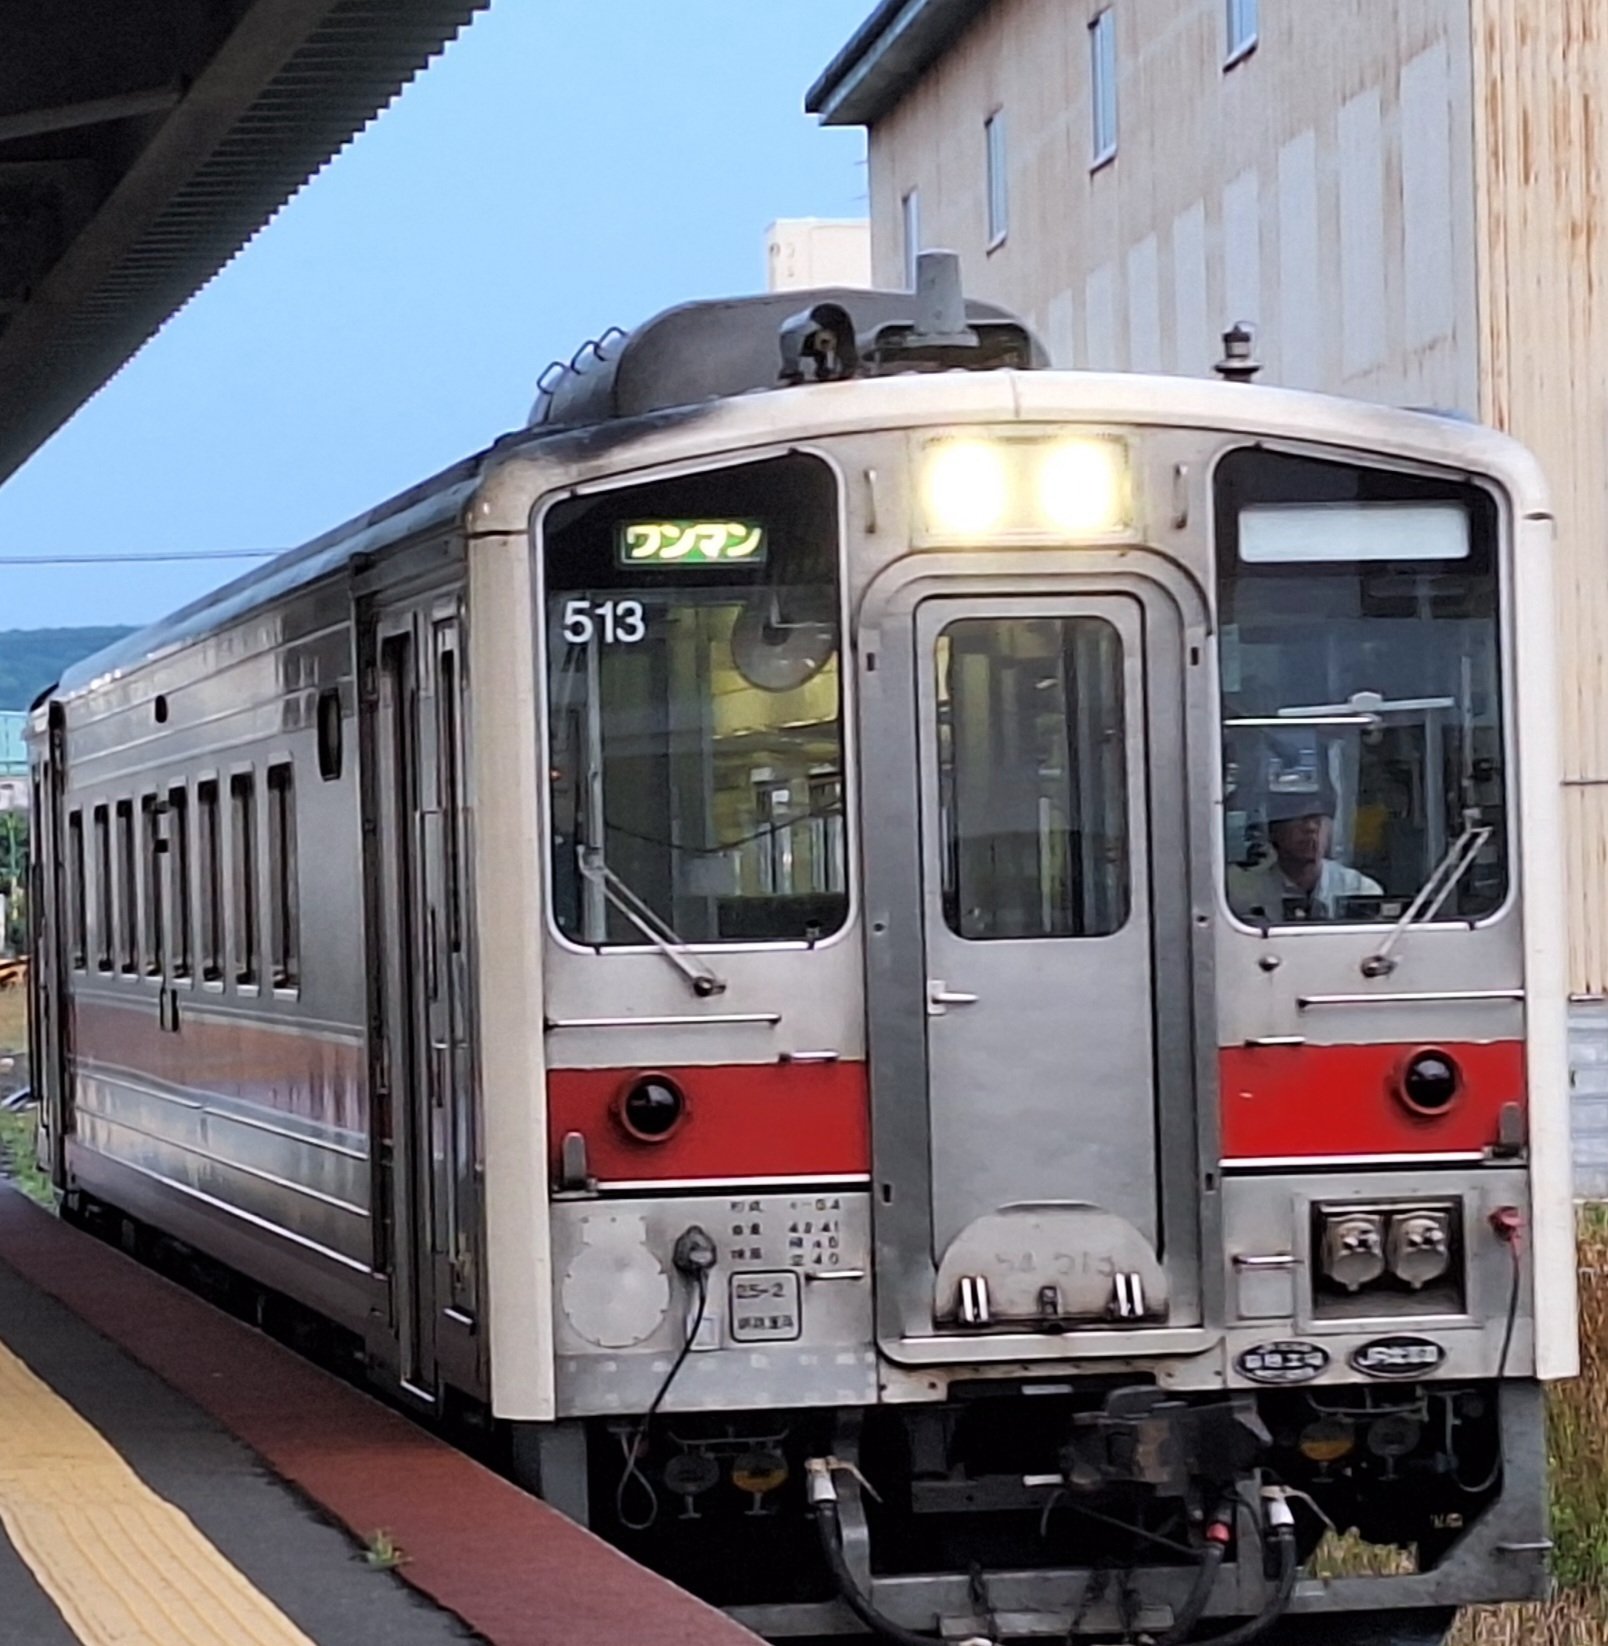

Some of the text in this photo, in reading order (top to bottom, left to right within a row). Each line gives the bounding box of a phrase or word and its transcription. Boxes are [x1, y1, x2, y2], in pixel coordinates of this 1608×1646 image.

[626, 523, 763, 559] ワンマン
[562, 600, 646, 644] 513
